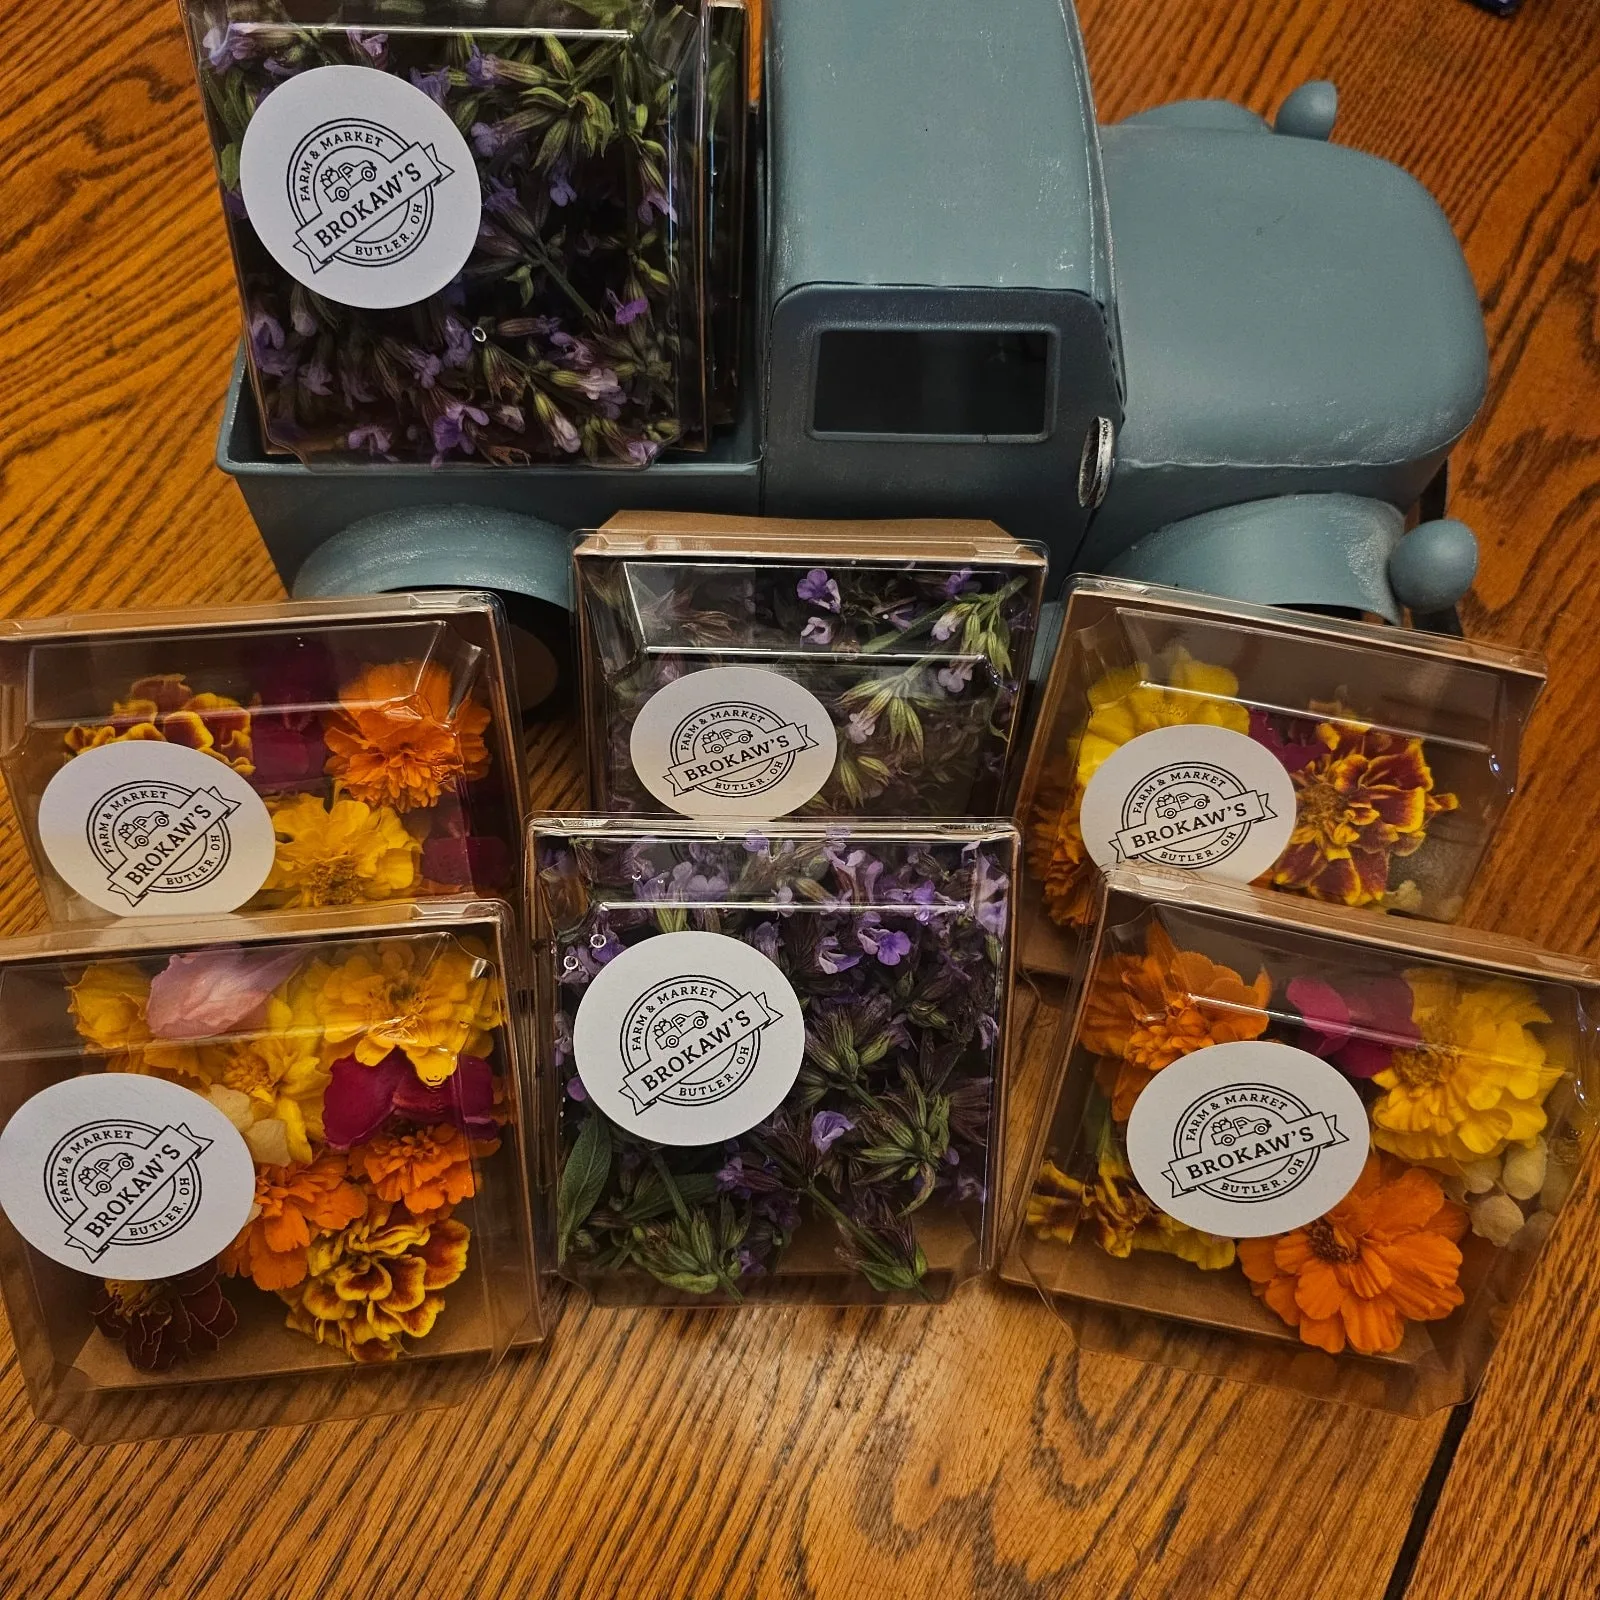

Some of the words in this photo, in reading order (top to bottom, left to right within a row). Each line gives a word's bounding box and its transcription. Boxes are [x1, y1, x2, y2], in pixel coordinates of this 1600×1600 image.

[300, 160, 313, 202] FARM
[309, 150, 320, 160] &
[320, 131, 384, 150] MARKET
[314, 162, 421, 248] BROKAW'S
[410, 203, 423, 225] OH
[680, 724, 699, 751] FARM
[710, 709, 766, 723] MARKET
[683, 735, 790, 781] BROKAW'S
[769, 760, 784, 775] OH
[110, 790, 169, 811] MARKET
[1132, 784, 1156, 814] FARM
[1157, 778, 1166, 786] &
[1170, 771, 1227, 787] MARKET
[102, 812, 113, 820] &
[1131, 802, 1247, 849] BROKAW'S
[98, 822, 115, 854] FARM
[125, 804, 212, 885] BROKAW'S
[210, 834, 220, 851] OH
[1220, 831, 1237, 847] OH
[631, 1015, 648, 1051] FARM
[645, 1005, 656, 1013] &
[656, 985, 718, 1004] MARKET
[640, 1009, 751, 1092] BROKAW'S
[736, 1046, 750, 1064] OH
[1186, 1109, 1210, 1141] FARM
[1209, 1102, 1220, 1110] &
[1223, 1093, 1288, 1111] MARKET
[62, 1156, 74, 1164] &
[70, 1130, 134, 1154] MARKET
[1185, 1126, 1314, 1180] BROKAW'S
[57, 1167, 74, 1204] FARM
[1287, 1158, 1304, 1176] OH
[84, 1143, 180, 1239] BROKAW'S
[179, 1177, 191, 1196] OH
